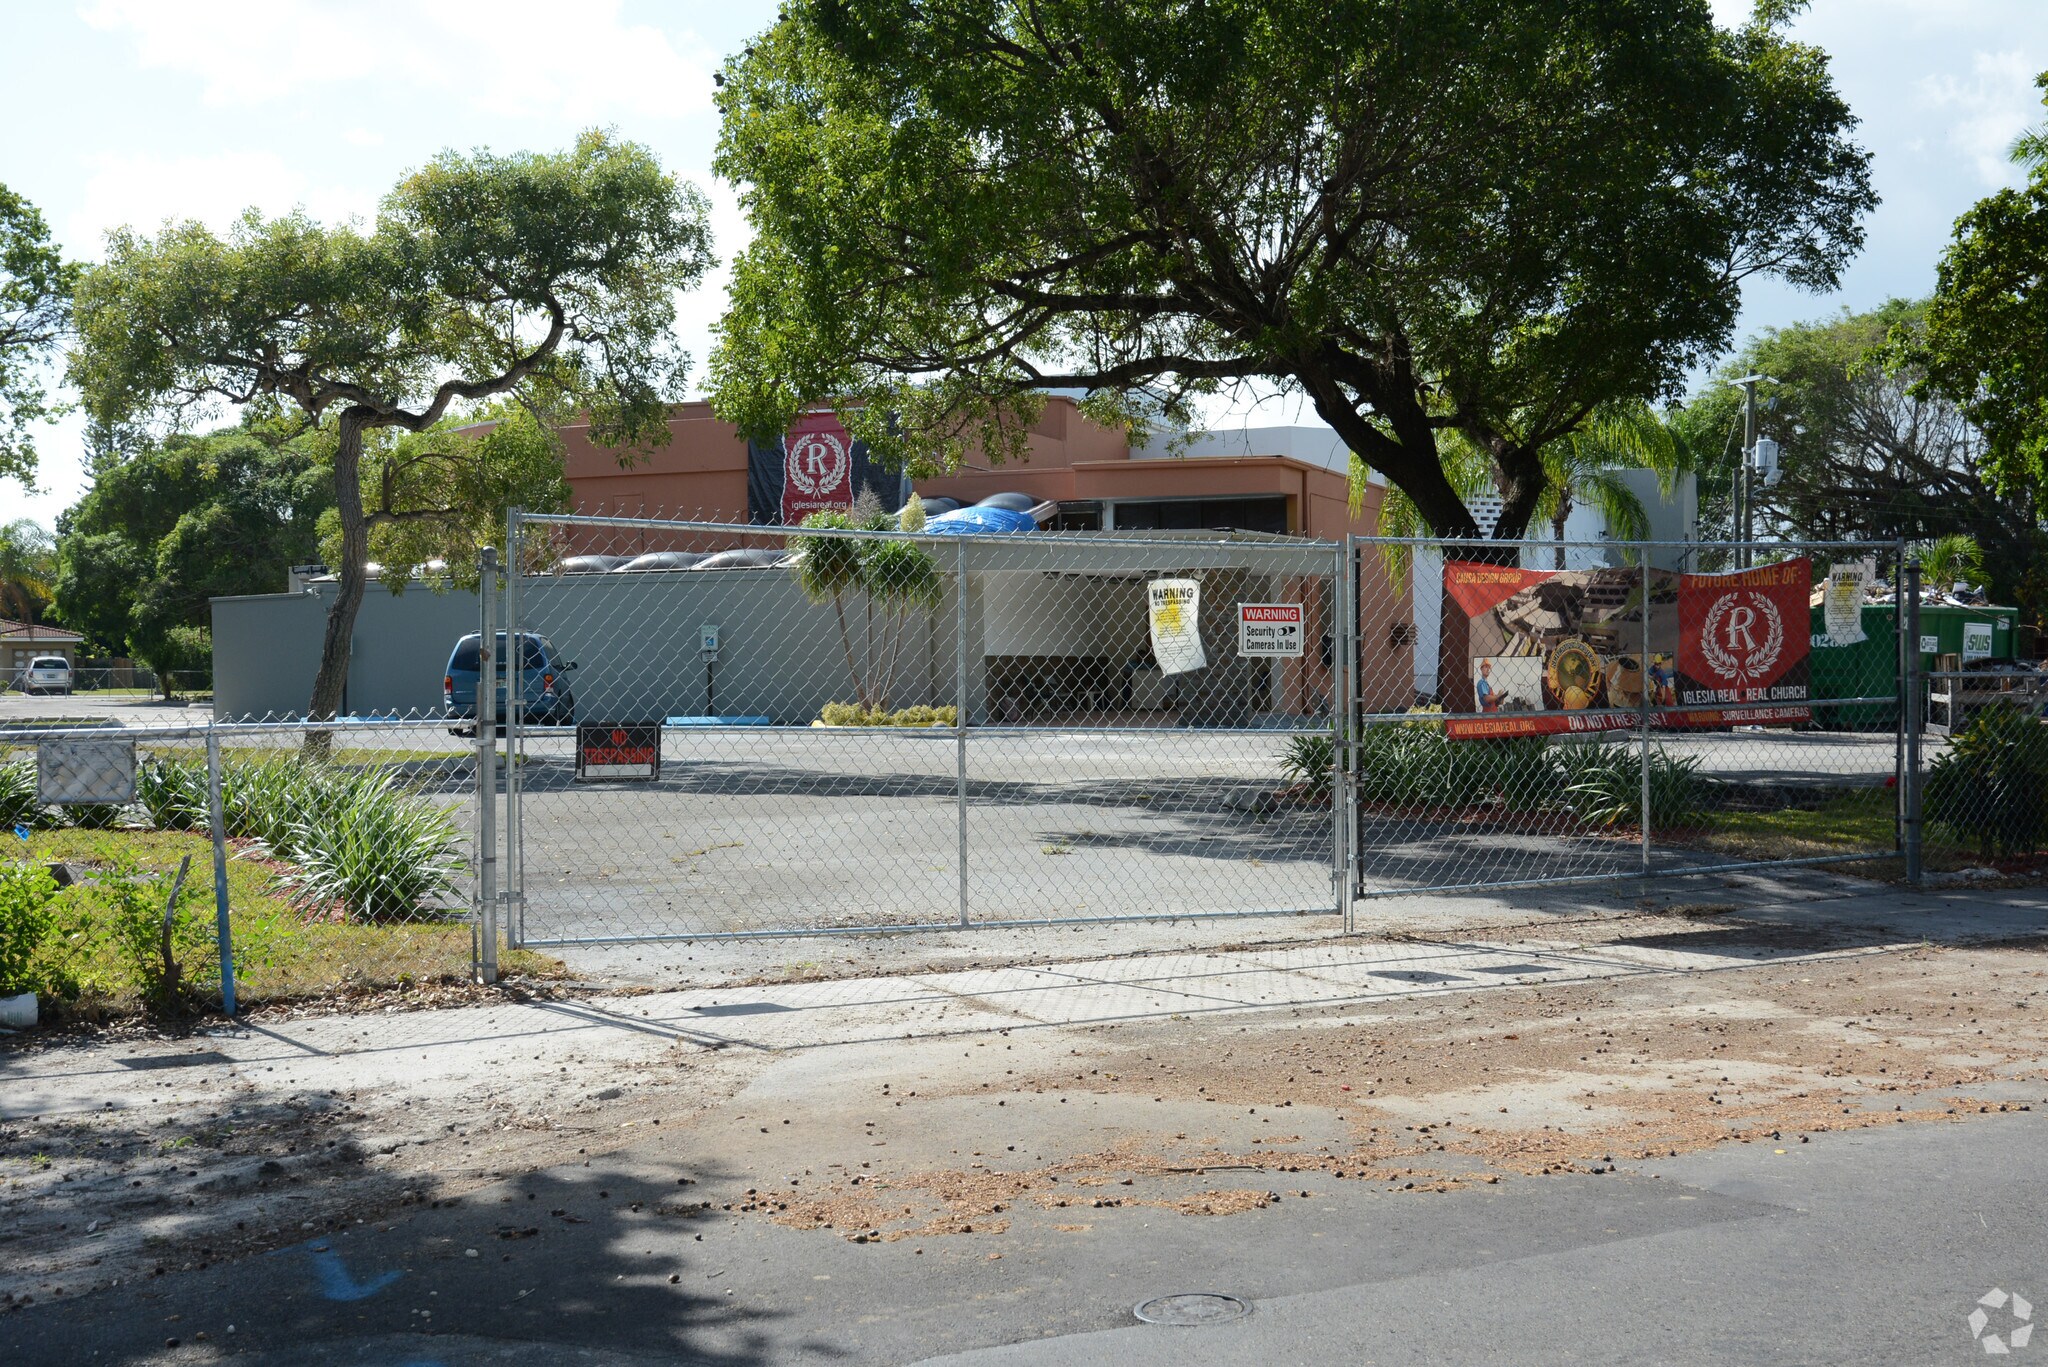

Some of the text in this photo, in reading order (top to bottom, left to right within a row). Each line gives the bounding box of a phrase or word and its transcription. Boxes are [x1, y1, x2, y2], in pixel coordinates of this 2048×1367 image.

[806, 443, 831, 476] R
[791, 500, 847, 511] iglesiareal.org
[1691, 575, 1740, 588] FUTURE
[1782, 566, 1802, 585] OF:
[1832, 572, 1863, 582] WARNING
[1153, 588, 1194, 601] WARNING
[1245, 609, 1297, 620] WARNING
[1246, 625, 1276, 639] Security
[1726, 606, 1759, 651] R
[1246, 638, 1297, 650] Cameras In Use
[1968, 634, 1991, 651] SWS
[1683, 685, 1807, 704] IGLESIA REAL REAL CHURCH
[1568, 715, 1585, 730] DO
[1587, 714, 1608, 729] NOT
[1608, 712, 1661, 729] TRESPSS
[1722, 709, 1774, 721] SURVEILLANCE
[1774, 707, 1809, 719] CAMERAS
[612, 730, 628, 745] NO
[584, 747, 655, 764] TRESPASSING
